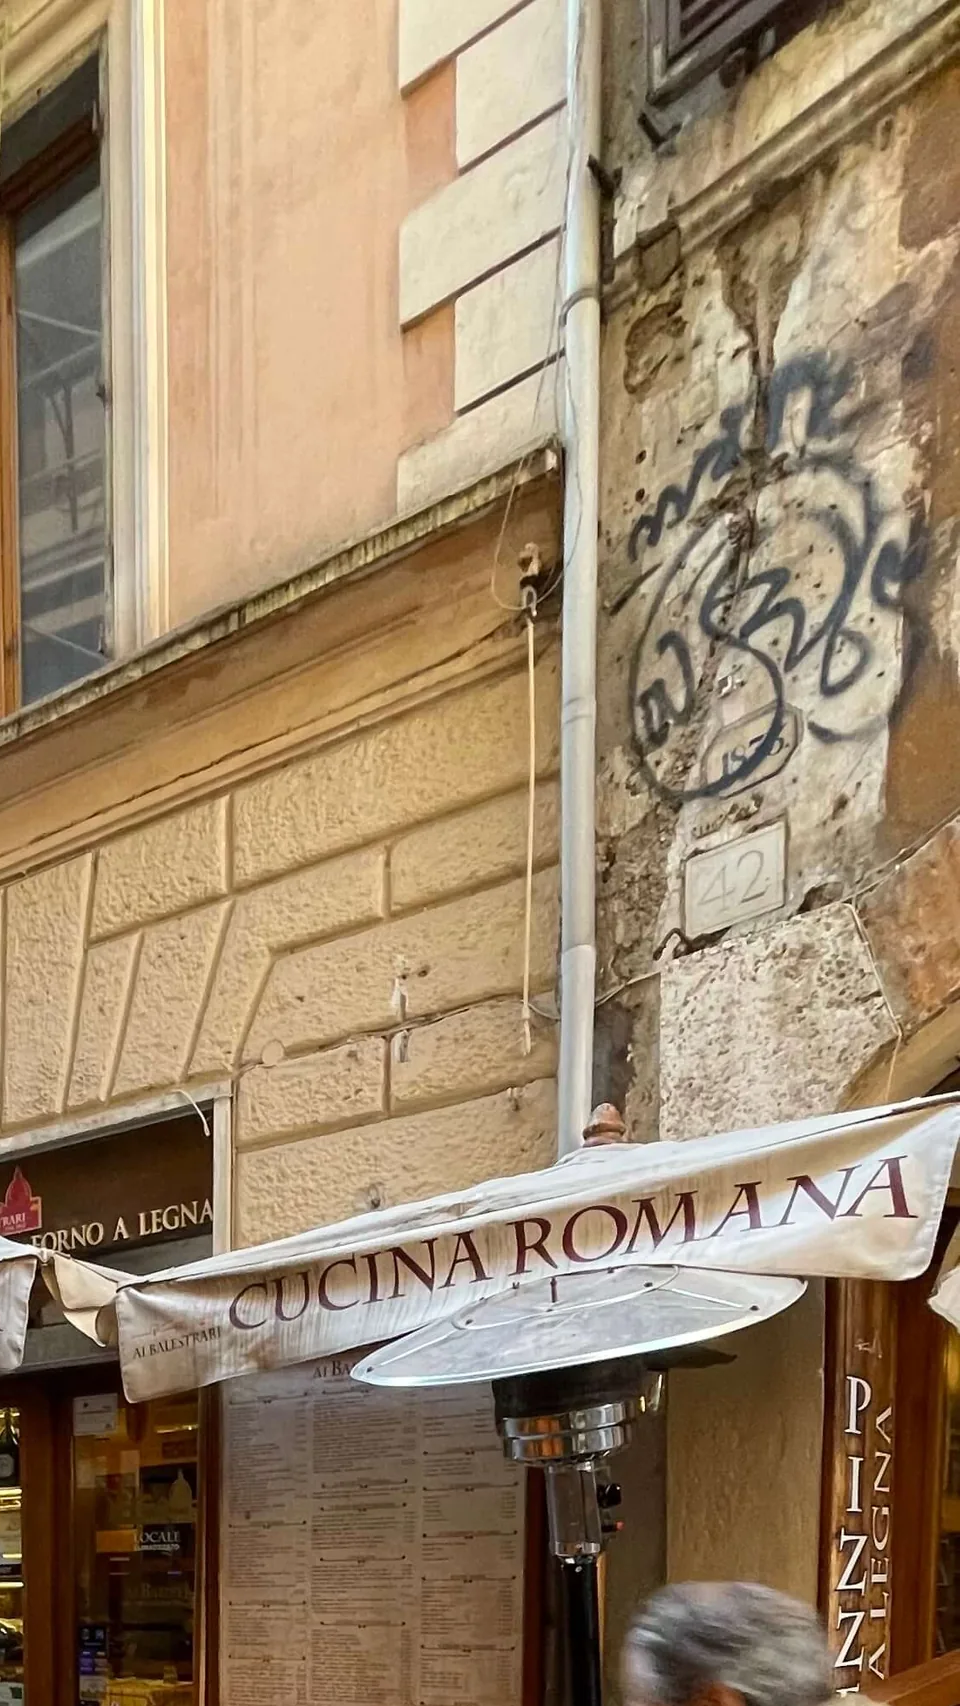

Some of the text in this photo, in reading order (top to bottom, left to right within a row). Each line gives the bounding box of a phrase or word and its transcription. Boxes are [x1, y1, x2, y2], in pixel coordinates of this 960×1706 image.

[697, 849, 771, 911] 42
[31, 1198, 214, 1252] FORNO A LEGNA
[229, 1154, 919, 1330] CUCINA ROMANA
[149, 1325, 222, 1357] BALESTRARI
[870, 1405, 892, 1619] LEGNA
